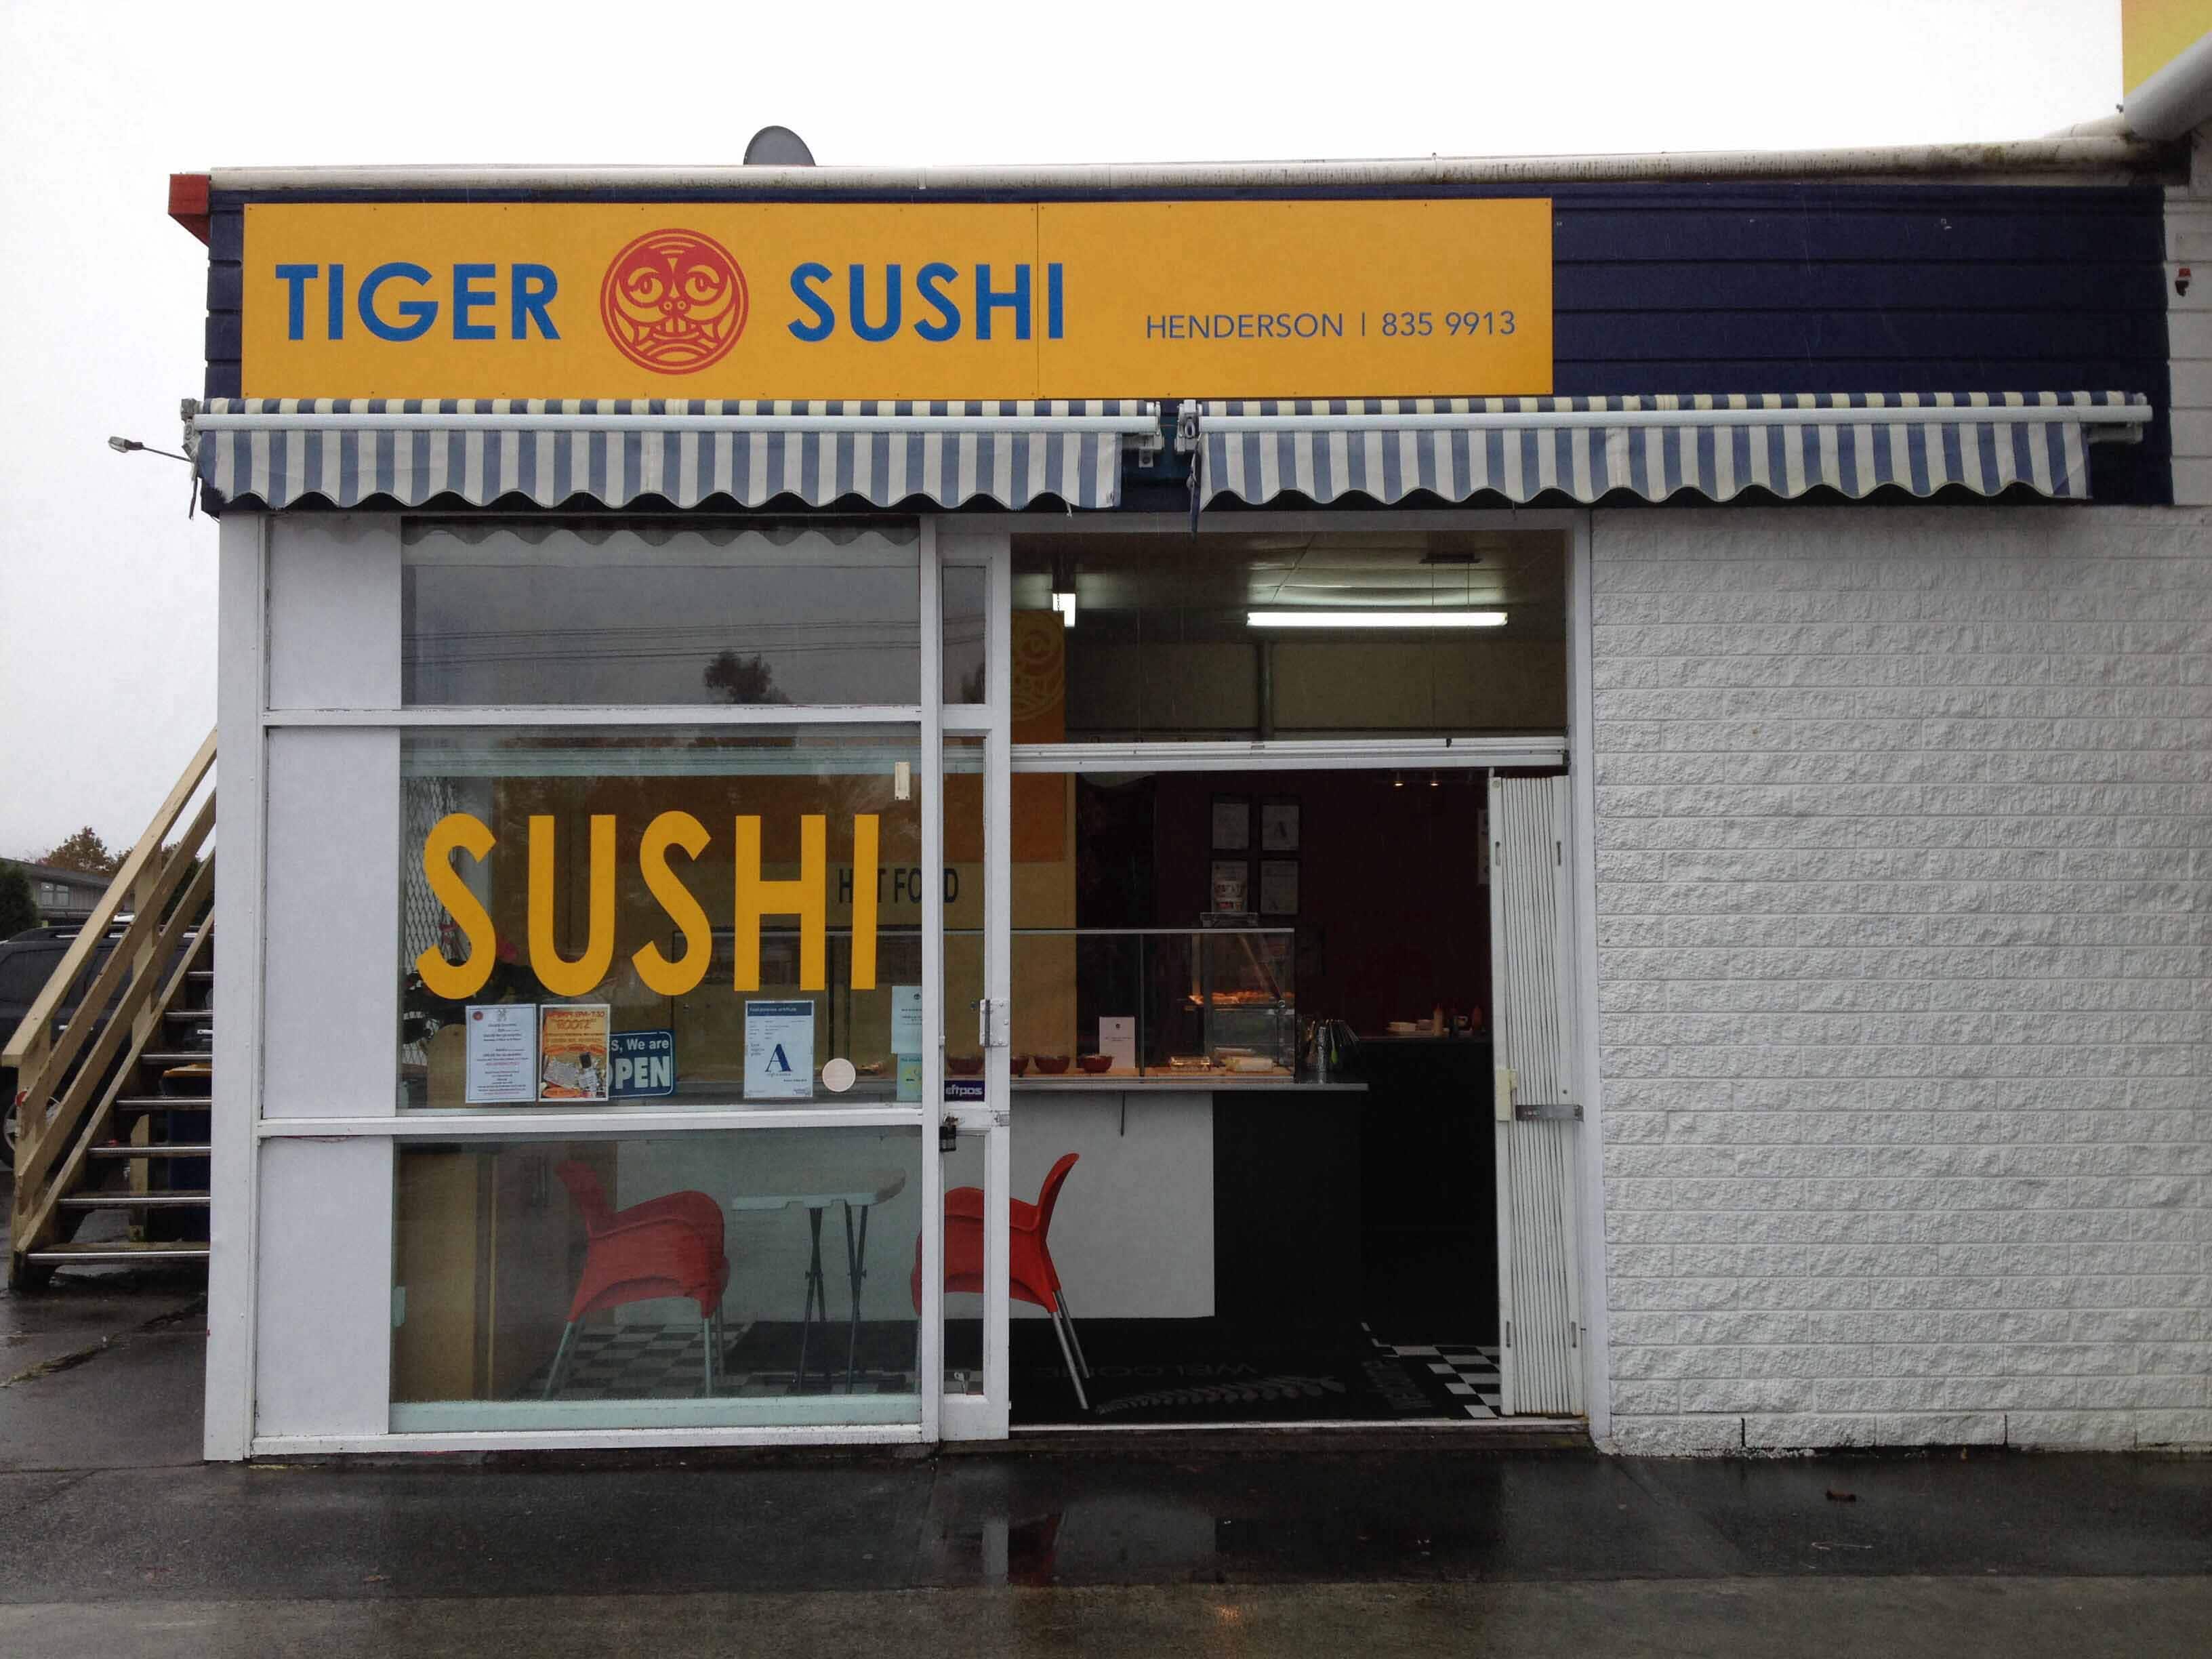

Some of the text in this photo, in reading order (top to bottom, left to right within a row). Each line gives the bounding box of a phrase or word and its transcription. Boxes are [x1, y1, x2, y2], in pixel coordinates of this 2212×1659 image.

[276, 262, 1063, 342] TIGER SUSHI
[1147, 313, 1343, 339] HENDERSON
[1382, 312, 1433, 337] 835
[1445, 310, 1516, 337] 9913
[839, 867, 959, 903] HT FOD
[415, 811, 879, 999] SUSHI
[627, 1038, 645, 1050] We
[649, 1040, 669, 1050] are
[765, 1044, 792, 1072] A
[609, 1056, 670, 1089] PEN
[945, 1084, 983, 1097] eftpos
